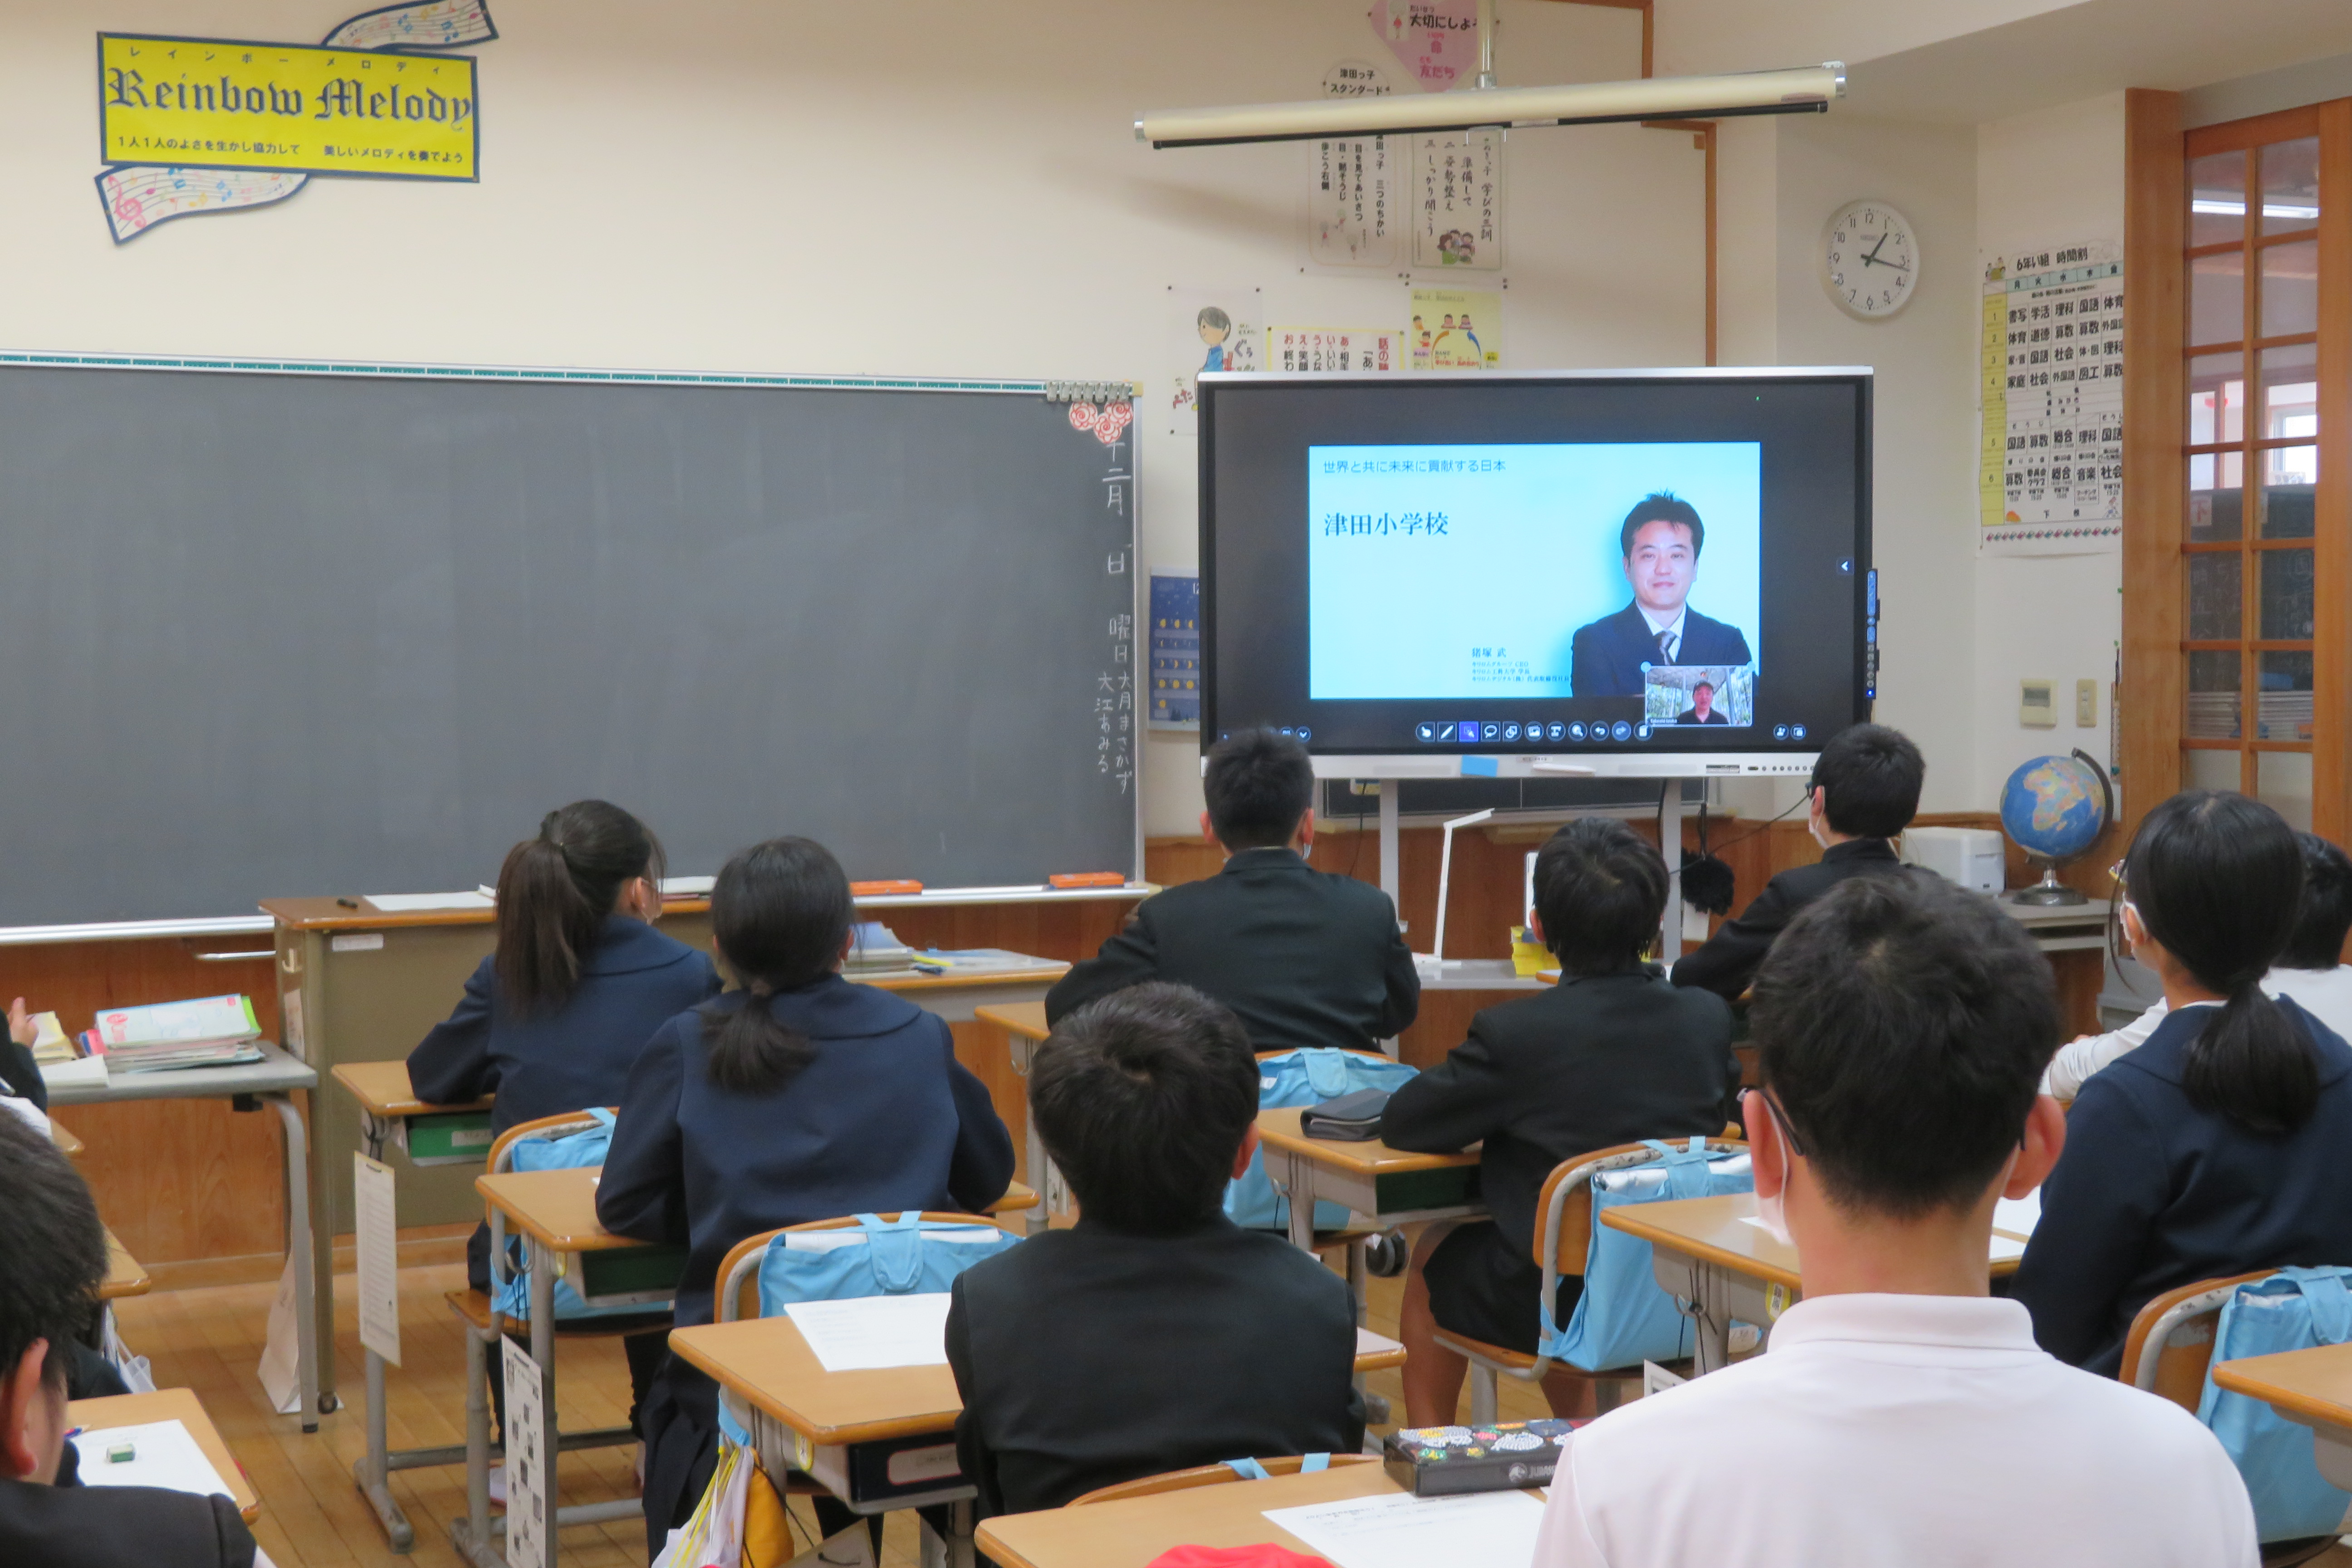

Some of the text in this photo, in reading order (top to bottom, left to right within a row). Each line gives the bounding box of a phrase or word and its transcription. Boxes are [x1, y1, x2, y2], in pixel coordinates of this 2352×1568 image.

[1431, 40, 1442, 54] 命
[130, 47, 440, 75] レインボー メロディ
[1340, 68, 1375, 80] 津田っ子
[1330, 83, 1383, 96] スタンダード
[108, 67, 472, 132] Reinbow Melody
[324, 145, 463, 163] 美しいメロディを奏でよう
[1850, 218, 1856, 229] 11
[1865, 212, 1874, 224] 12
[1837, 232, 1845, 243] 10
[1895, 233, 1901, 245] 2
[1833, 252, 1840, 264] 9
[2017, 247, 2087, 271] 6年い組 時間割
[1837, 273, 1844, 285] 8
[1896, 276, 1901, 287] 4
[1852, 289, 1857, 299] 7
[1866, 295, 1873, 307] 6
[1883, 290, 1890, 302] 5
[2031, 304, 2050, 321] 学活
[2055, 301, 2074, 316] 理科
[2079, 297, 2099, 314] 国語
[2104, 294, 2123, 310] 体育
[2008, 331, 2027, 345] 体育
[2031, 327, 2050, 342] 道徳
[2055, 324, 2074, 339] 算数
[2079, 320, 2099, 336] 算数
[2030, 349, 2049, 364] 国語
[2054, 346, 2074, 361] 社会
[2104, 340, 2123, 355] 理科
[2007, 373, 2026, 389] 家庭
[2030, 372, 2049, 386] 社会
[2053, 369, 2075, 382] 外国語
[2079, 365, 2099, 381] 図工
[2104, 363, 2123, 378] 算数
[2007, 435, 2026, 450] 国語
[2029, 433, 2049, 449] 算数
[2054, 429, 2073, 443] 総合
[2078, 429, 2097, 444] 理科
[2102, 427, 2122, 442] 国語
[1323, 459, 1507, 474] 世界と共に未来に貢献する日本
[1102, 441, 1132, 516] 十二月
[2006, 472, 2023, 486] 算数
[2052, 465, 2071, 480] 総合
[2077, 466, 2096, 481] 音楽
[2101, 464, 2122, 479] 社会
[1324, 511, 1449, 537] 津田小学校
[1109, 613, 1131, 664] 曜日
[1497, 647, 1507, 658] 武
